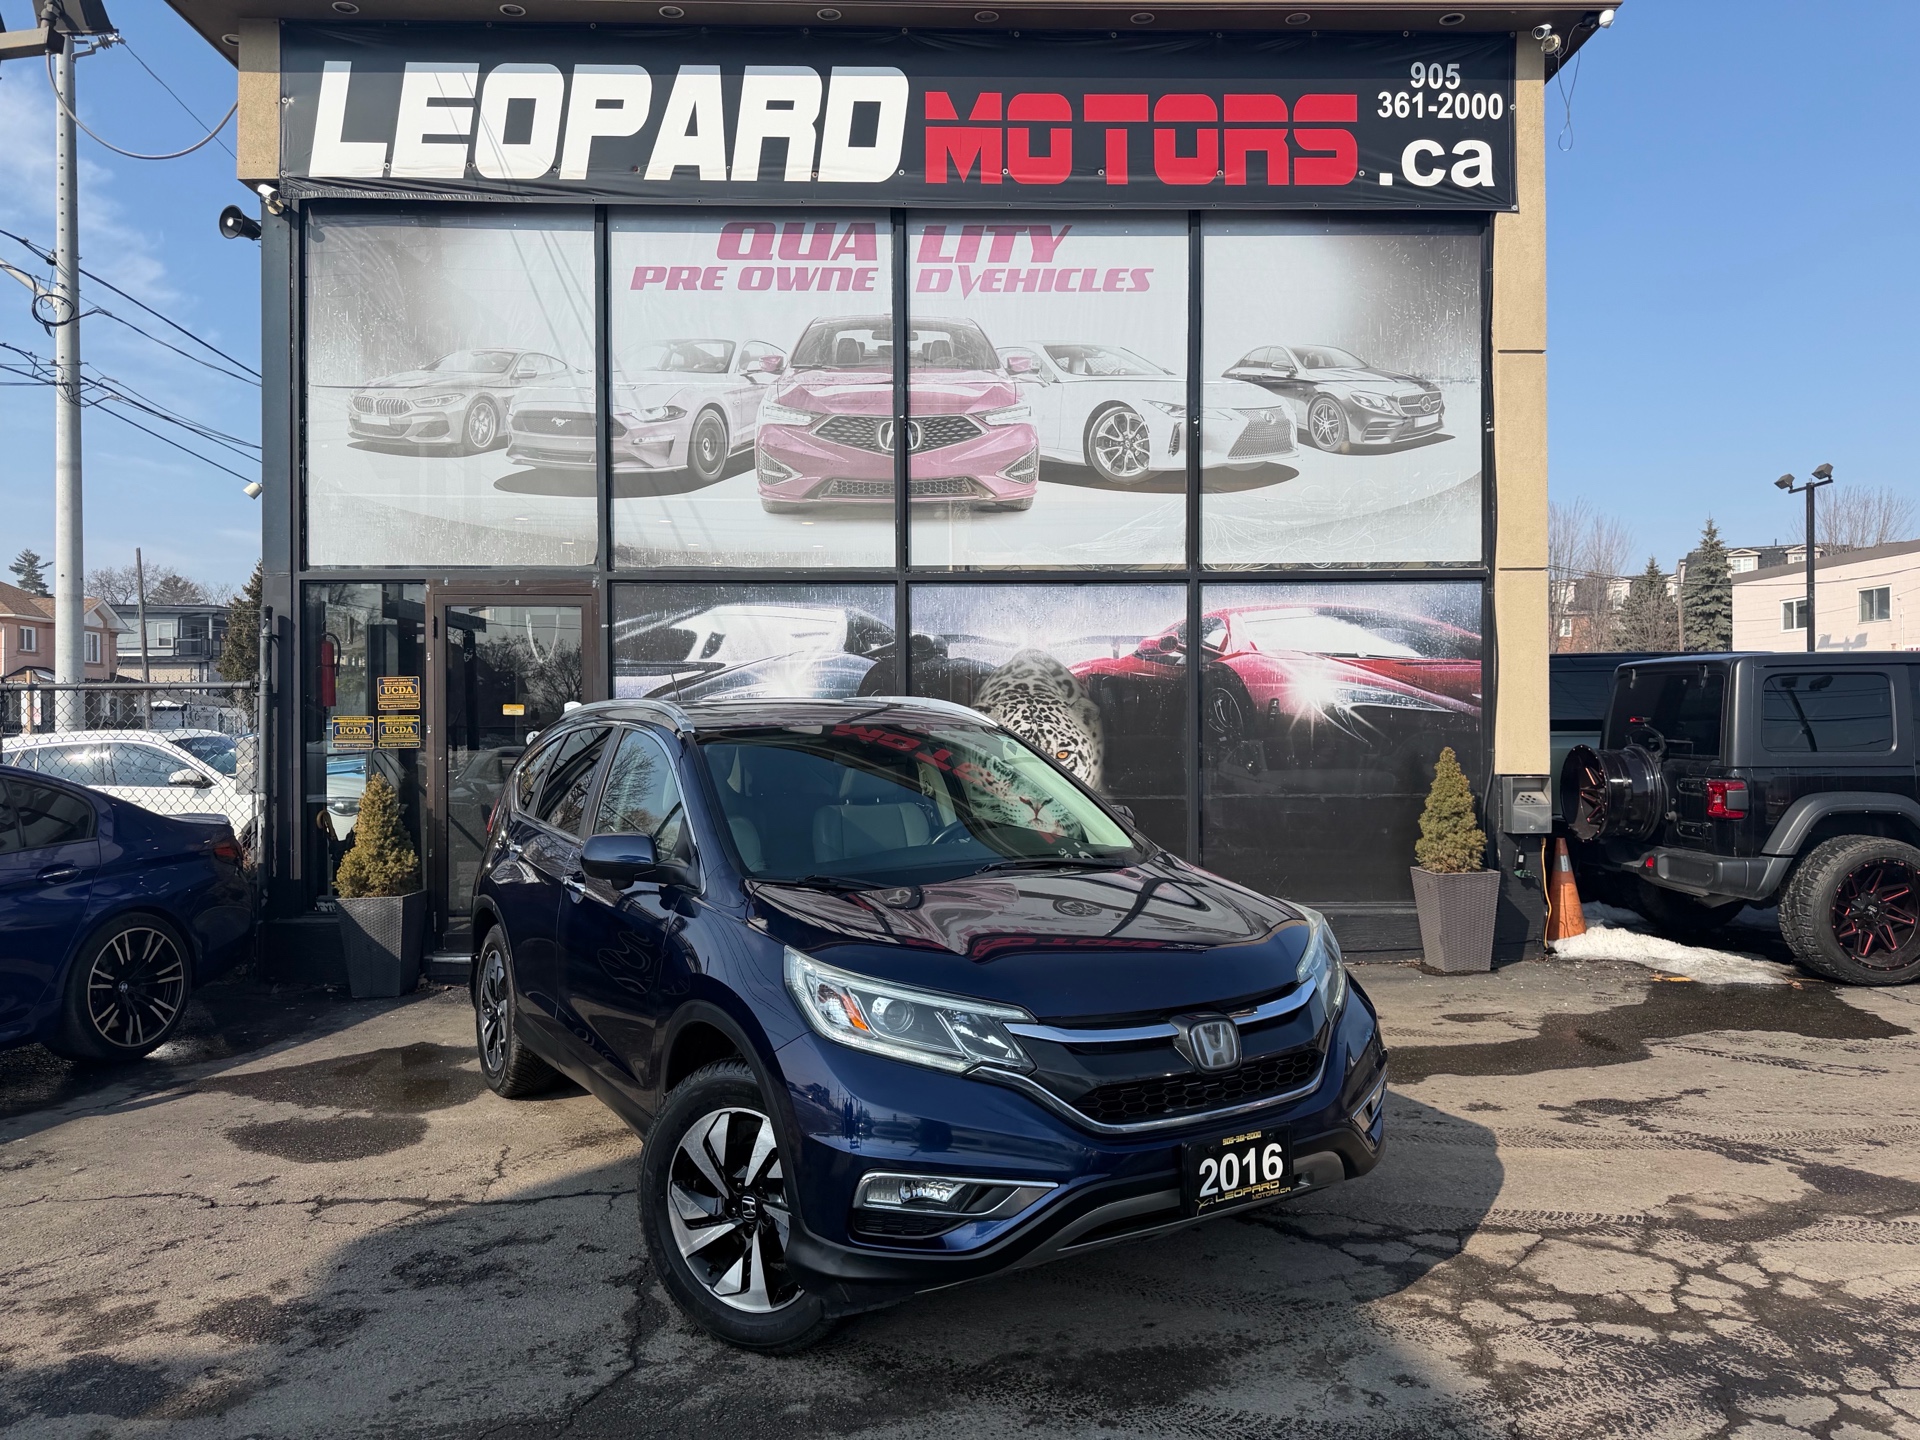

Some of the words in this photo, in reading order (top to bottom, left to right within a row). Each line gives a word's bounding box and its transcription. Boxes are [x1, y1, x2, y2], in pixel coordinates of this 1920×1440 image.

[1410, 61, 1461, 90] 905
[1377, 91, 1504, 120] 361-2000
[309, 61, 909, 183] LEOPARD
[925, 92, 1358, 185] MOTORS
[1379, 139, 1495, 188] .ca
[716, 222, 878, 261] QUA
[916, 224, 1073, 263] LITY
[630, 266, 728, 291] PRE
[384, 686, 414, 695] UCDA
[339, 726, 368, 735] UCDA
[385, 725, 414, 734] UCDA
[1199, 1142, 1284, 1198] 2016
[1215, 1180, 1280, 1203] LEOPARD
